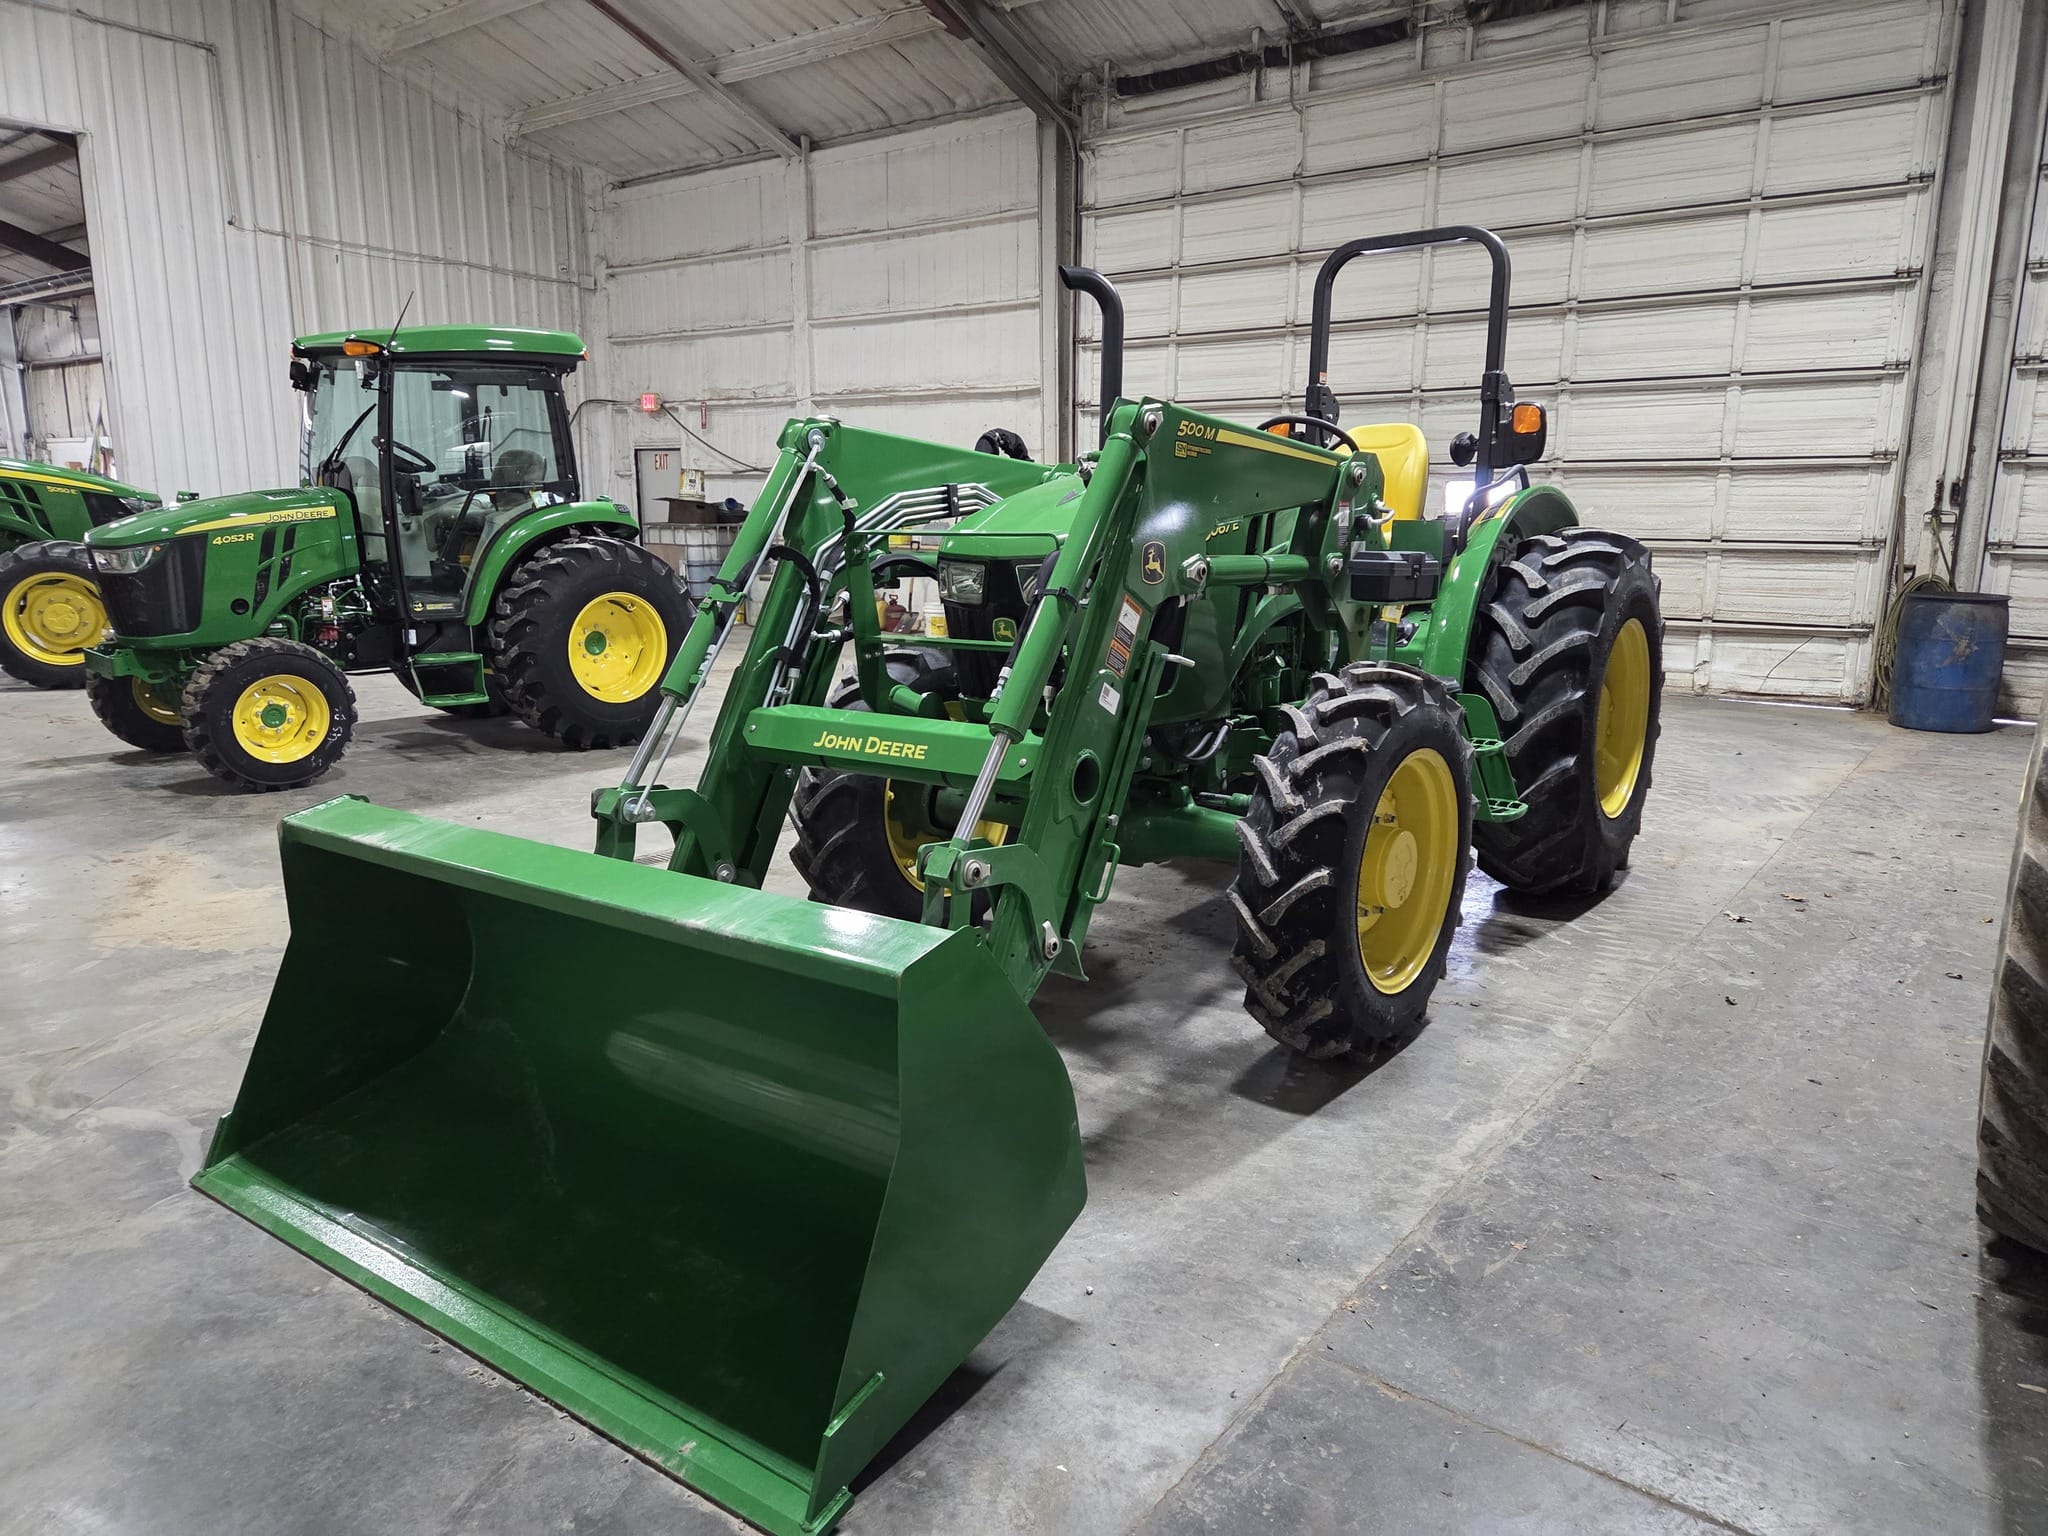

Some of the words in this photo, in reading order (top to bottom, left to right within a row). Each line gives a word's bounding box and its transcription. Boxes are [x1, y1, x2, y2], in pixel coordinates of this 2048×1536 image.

[654, 453, 669, 471] EXIT
[267, 511, 297, 523] JOHN
[296, 509, 329, 520] DEERE
[813, 731, 863, 752] JOHN
[865, 736, 928, 760] DEERE
